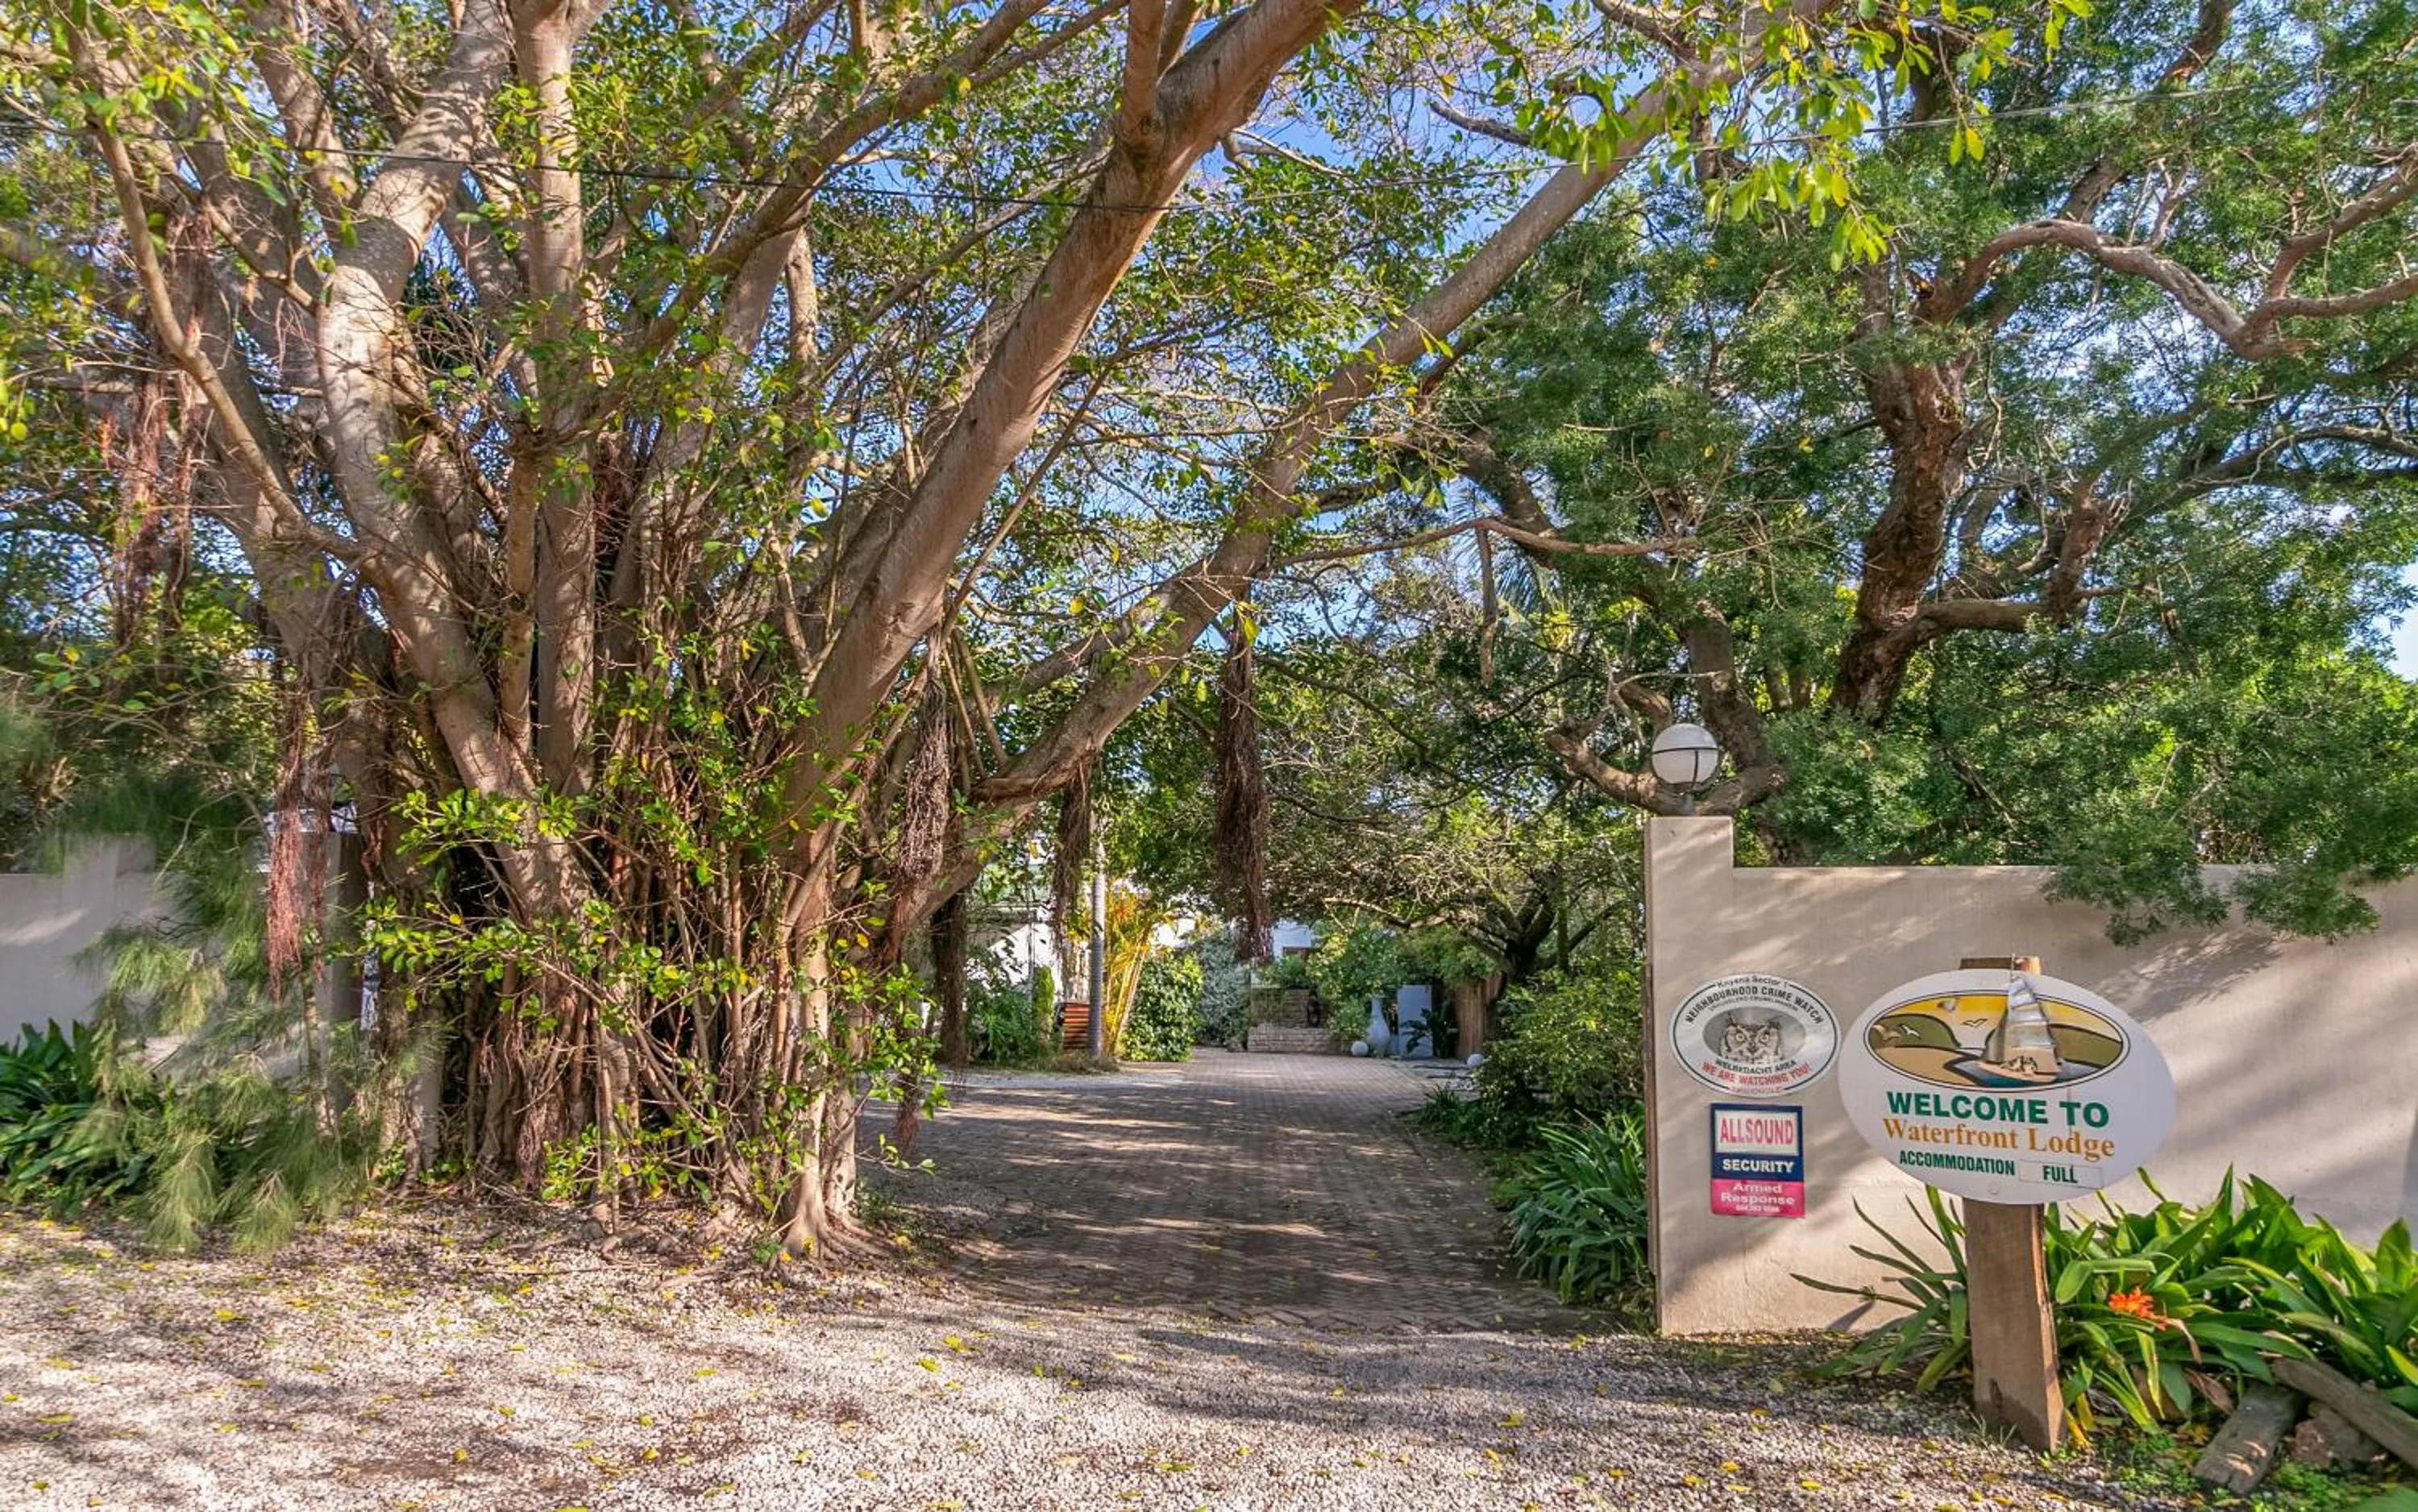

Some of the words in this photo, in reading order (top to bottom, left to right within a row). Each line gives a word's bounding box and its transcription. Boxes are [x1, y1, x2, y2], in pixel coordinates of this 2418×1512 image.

[1685, 986, 1758, 1024] NEIGHBOURHOOD
[1761, 986, 1793, 1002] CRIME
[1794, 995, 1824, 1024] WATCH
[1701, 1061, 1717, 1076] WE
[1718, 1070, 1735, 1082] ARE
[1739, 1073, 1789, 1085] WATCHING
[1886, 1090, 2048, 1124] WELCOME
[2059, 1100, 2109, 1129] TO
[1719, 1117, 1794, 1145] ALLSOUND
[1882, 1118, 2018, 1149] Waterfront
[2024, 1128, 2116, 1163] Lodge
[1722, 1158, 1794, 1173] SECURITY
[1899, 1149, 2015, 1176] ACCOMMODATION
[2042, 1164, 2078, 1184] FULL
[1720, 1192, 1796, 1207] Response
[1733, 1182, 1782, 1194] Armed
